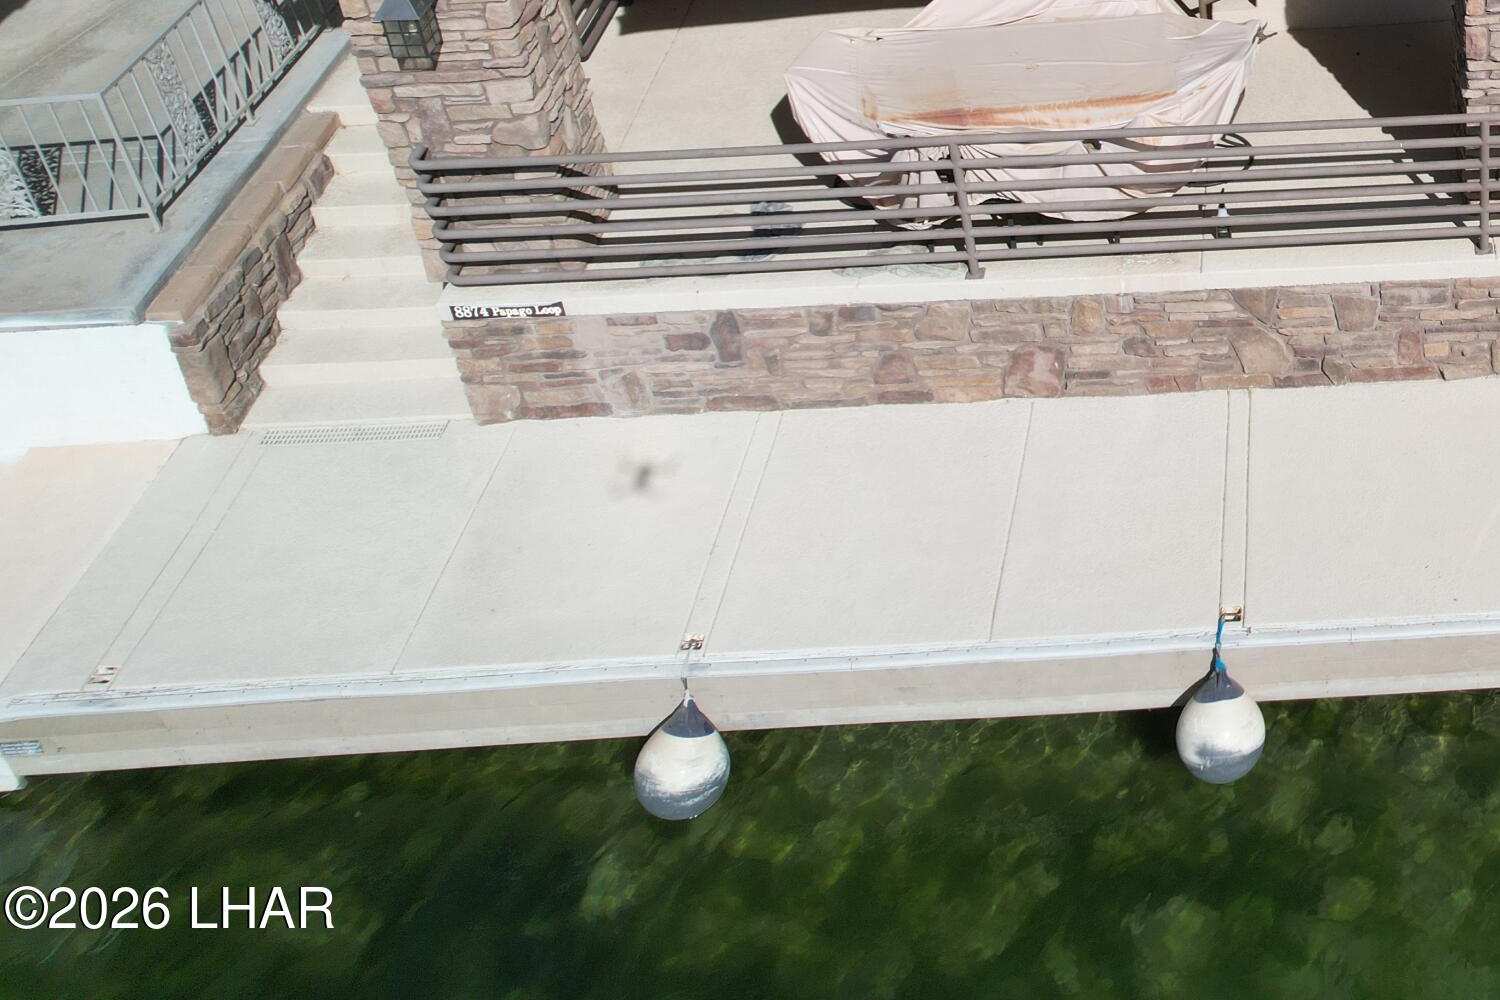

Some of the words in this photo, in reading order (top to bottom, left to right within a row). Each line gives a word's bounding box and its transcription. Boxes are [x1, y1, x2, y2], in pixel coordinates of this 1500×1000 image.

[453, 306, 489, 319] 8874
[492, 306, 533, 319] Papago
[533, 304, 562, 317] Loop
